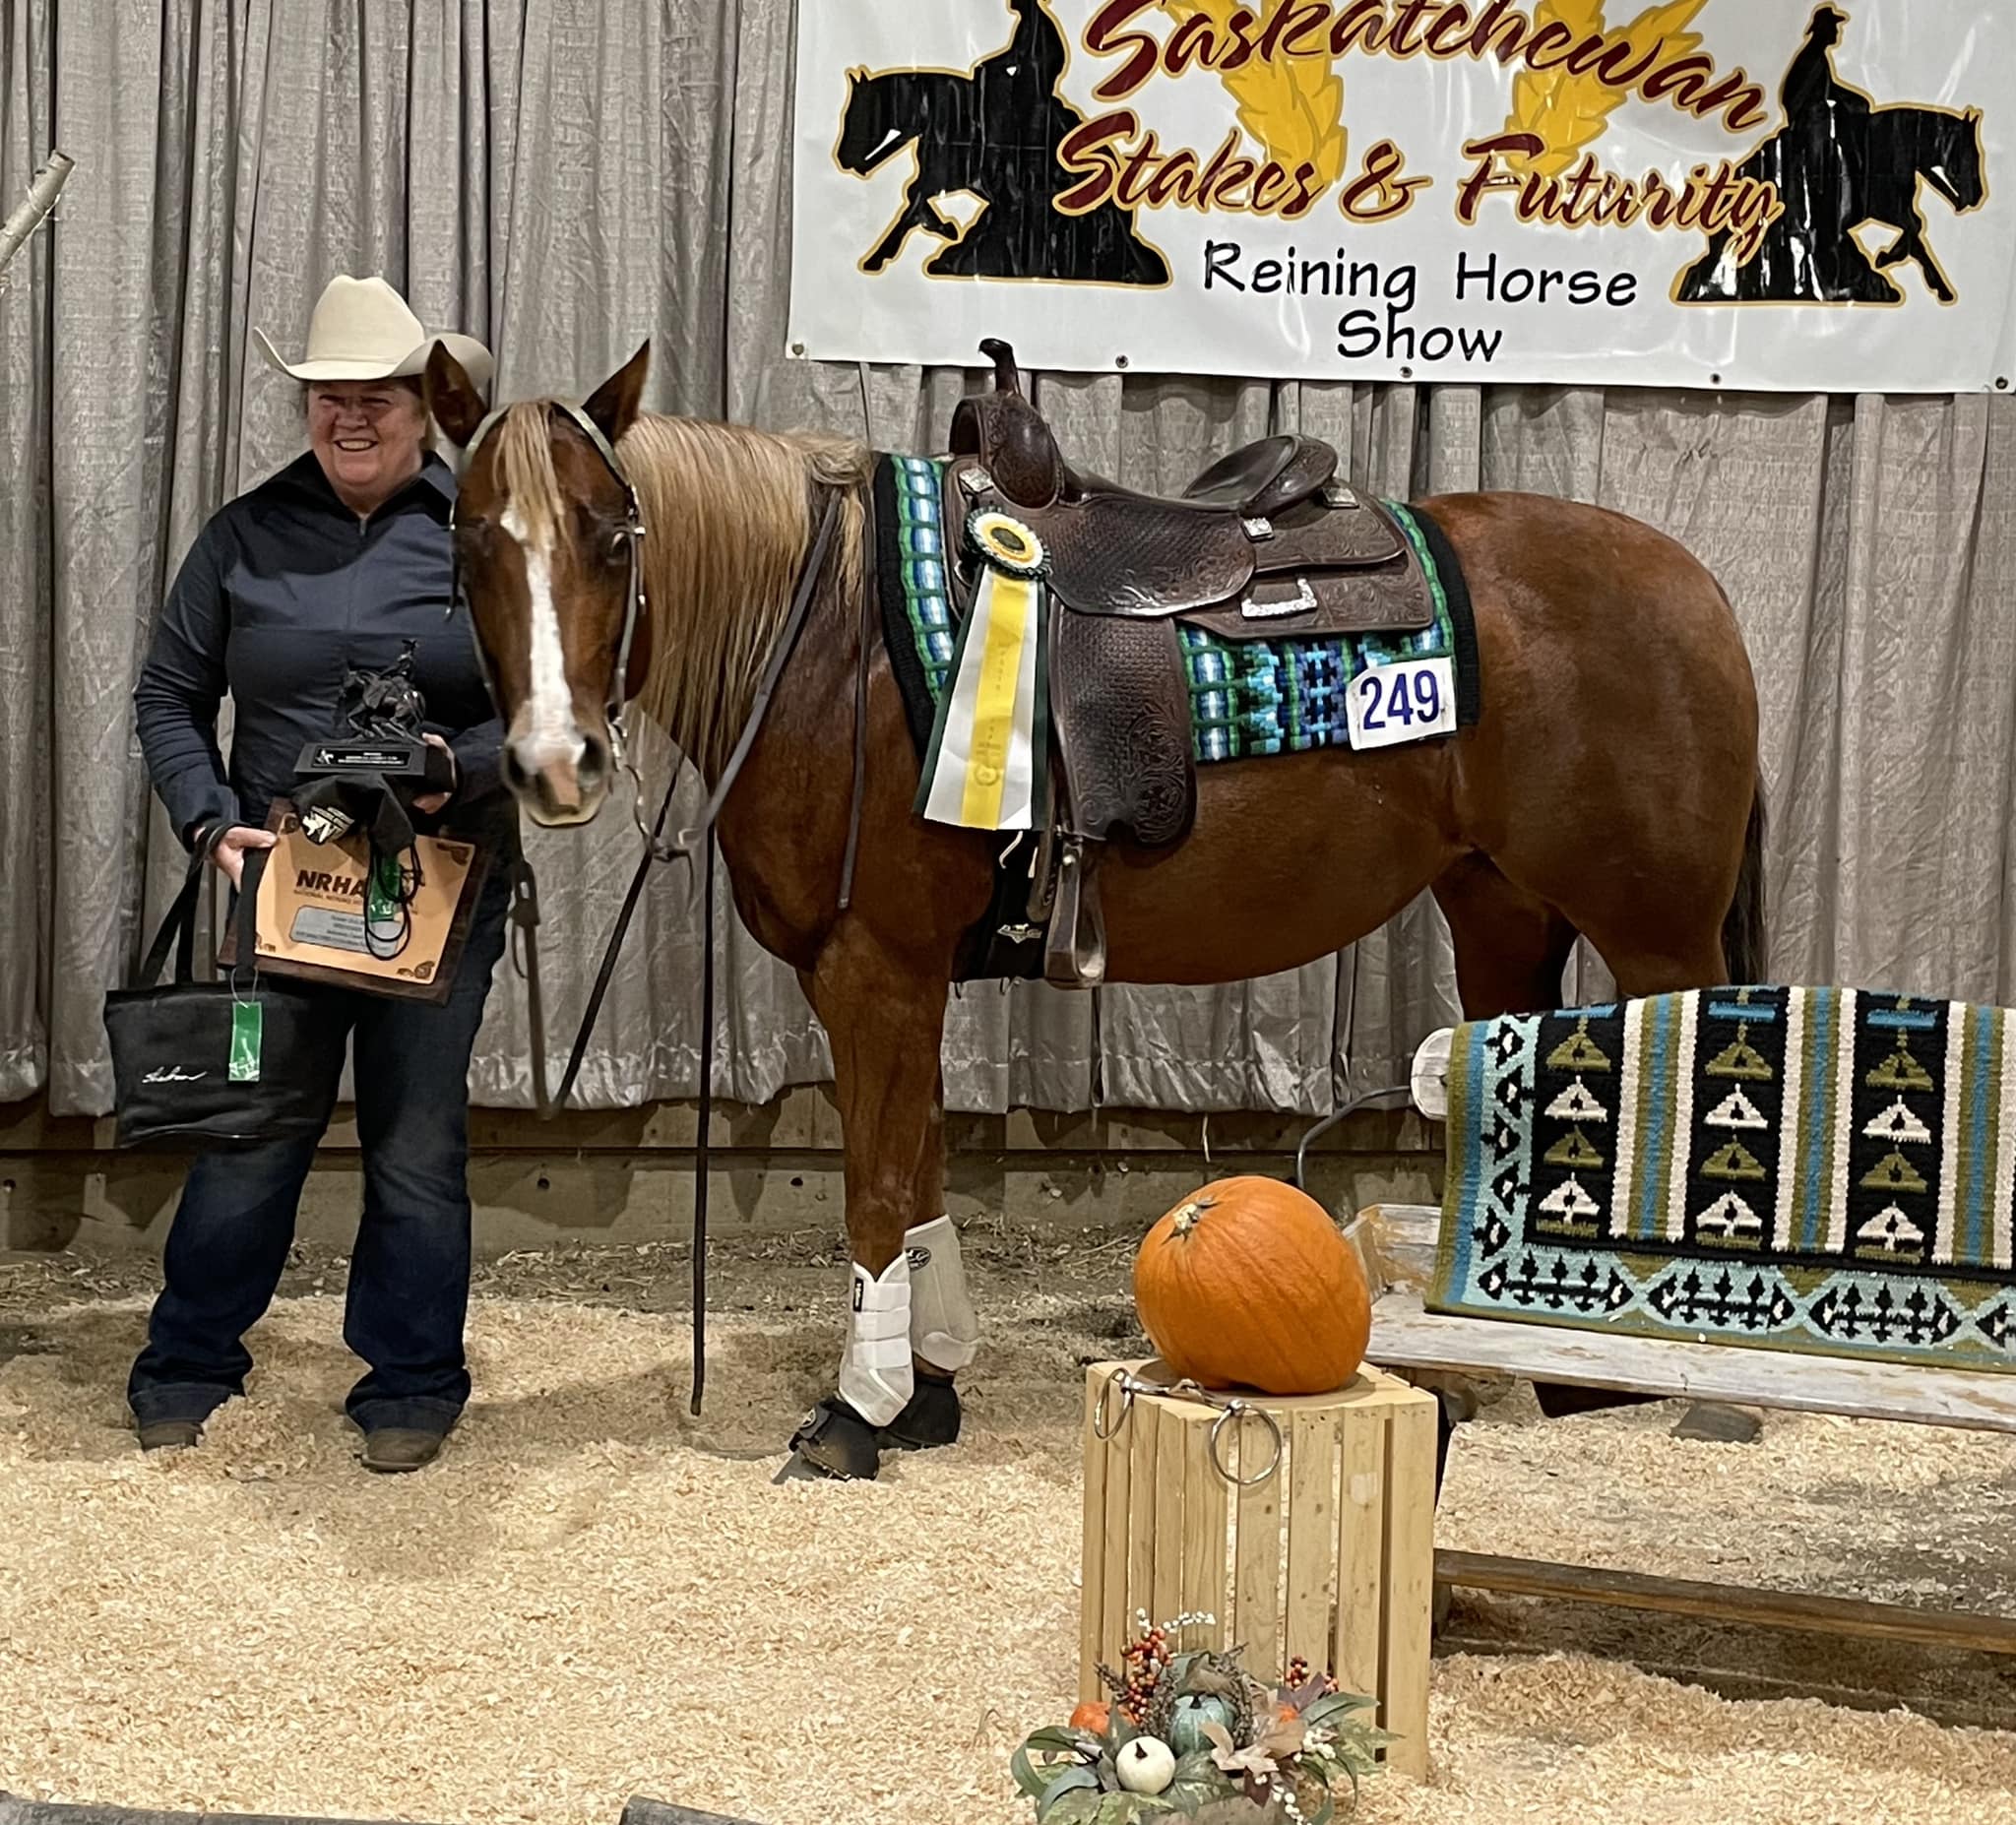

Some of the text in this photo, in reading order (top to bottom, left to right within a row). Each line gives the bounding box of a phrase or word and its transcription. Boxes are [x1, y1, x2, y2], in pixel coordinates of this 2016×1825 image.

[1085, 0, 1769, 130] Saskatchewan
[1054, 109, 1784, 265] Stakes & Futurity
[1204, 239, 1637, 313] Reining Horse
[1336, 303, 1502, 362] Show
[1359, 669, 1440, 730] 249
[295, 869, 365, 899] NRHA
